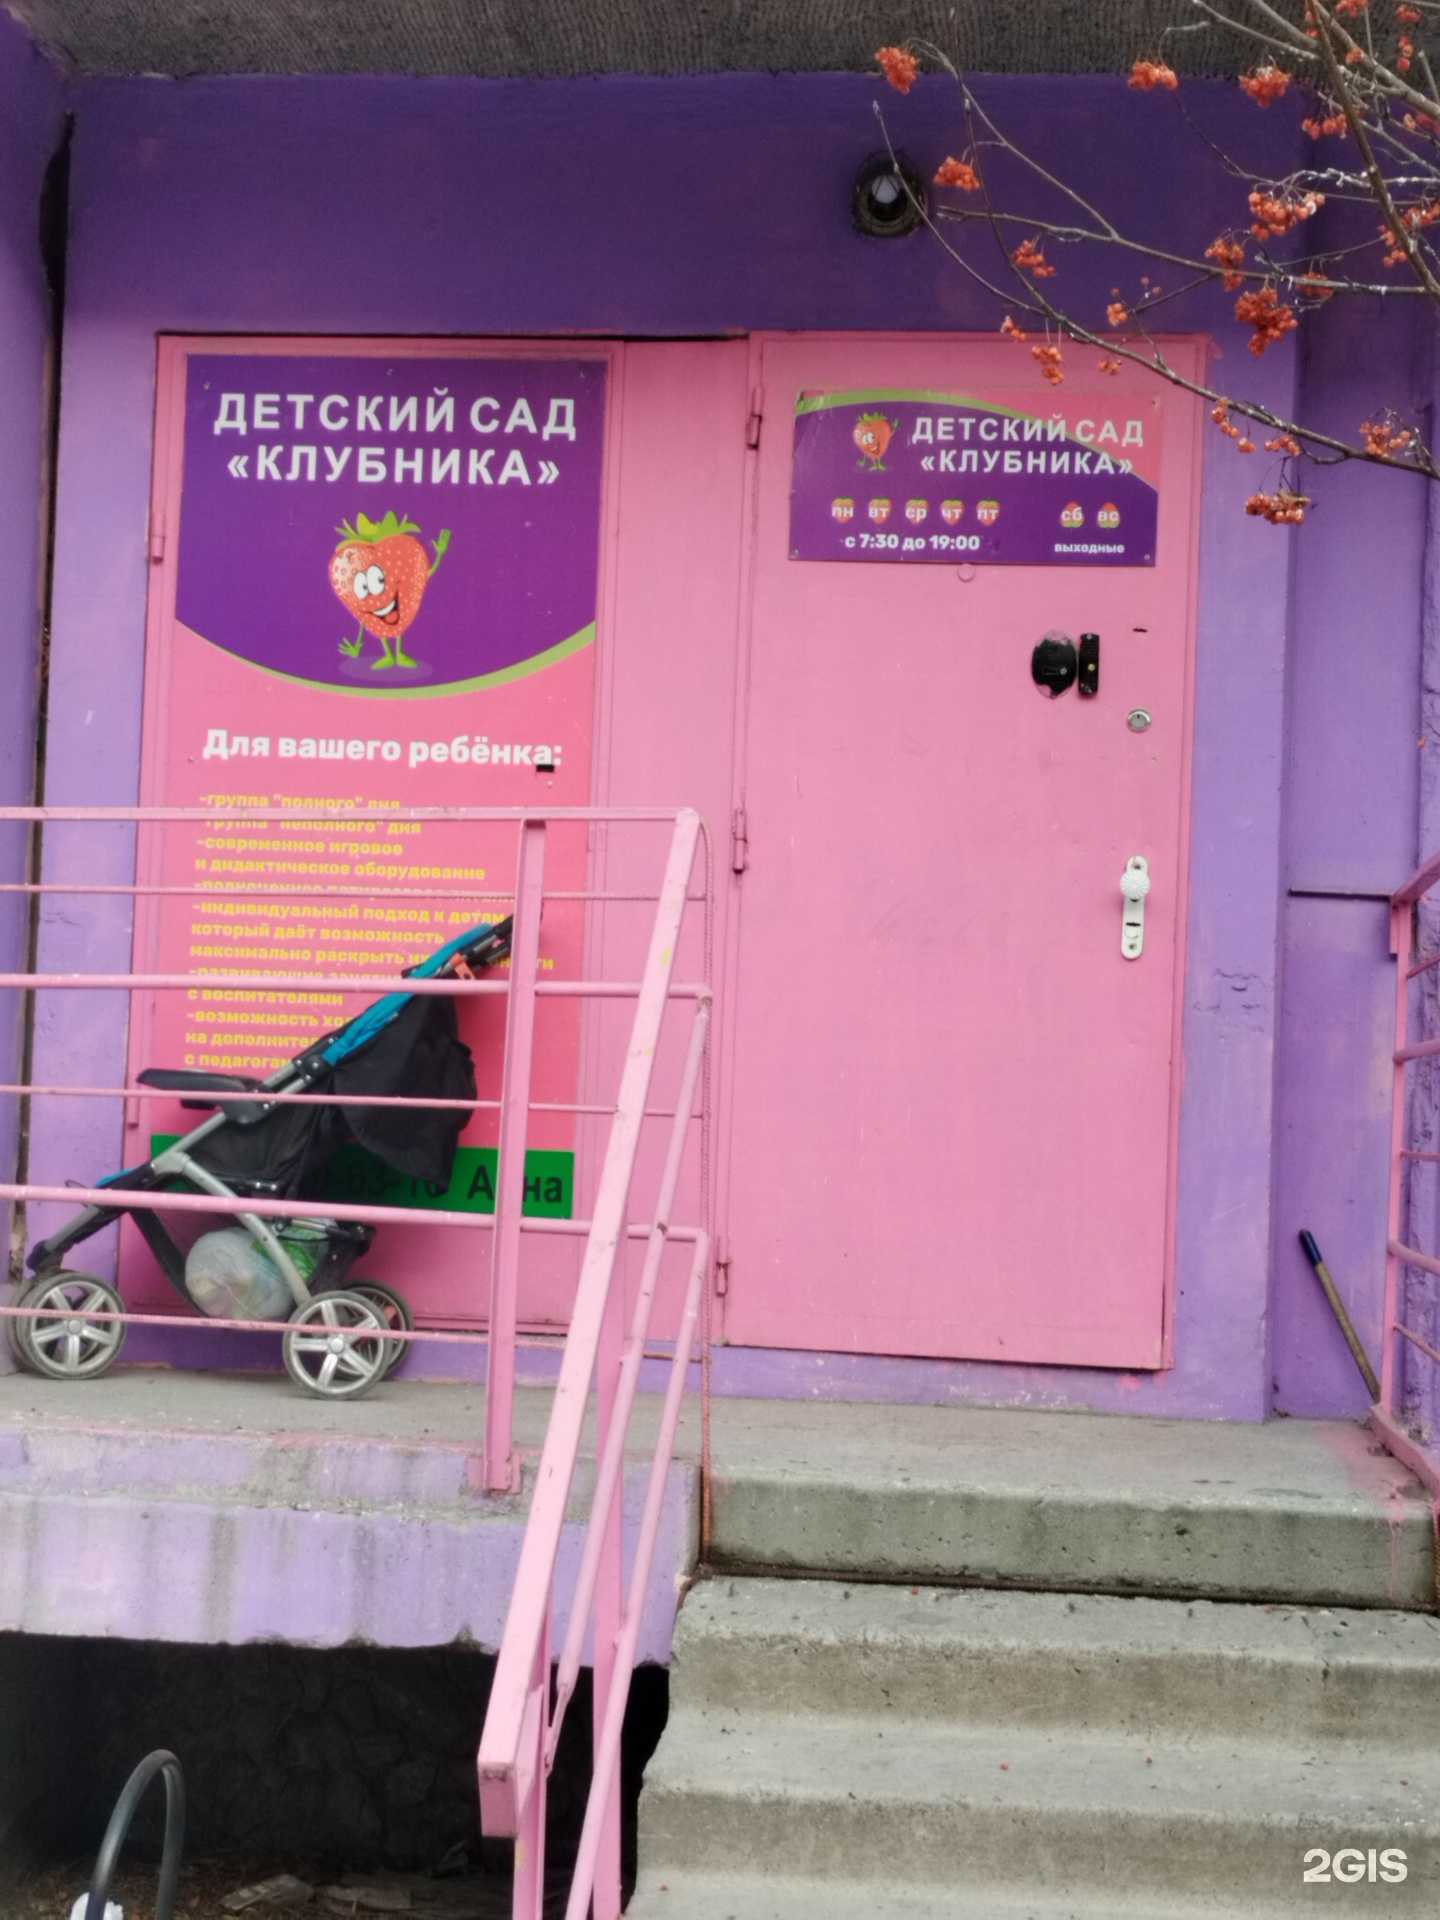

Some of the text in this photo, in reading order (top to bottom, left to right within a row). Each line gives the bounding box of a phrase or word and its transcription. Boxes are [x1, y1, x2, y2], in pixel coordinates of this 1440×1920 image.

[213, 386, 577, 441] ДЕТСКИЙ САД
[912, 413, 1145, 448] ДЕТСКИЙ САД
[227, 444, 560, 486] «КЛУБНИКА»
[921, 449, 1134, 475] «КЛУБНИКА»
[831, 506, 999, 524] пн вт ср чт пт
[1061, 506, 1119, 522] сб вс
[844, 533, 980, 551] с 7:30 до 19:00
[1054, 543, 1125, 554] выходные
[203, 728, 563, 768] Для вашего ребёнка:
[387, 821, 421, 835] дня
[197, 837, 403, 856] -современное игровое
[195, 859, 485, 881] и дидактическое оборудование
[362, 907, 431, 923] подход
[434, 911, 445, 922] к
[191, 922, 445, 944] который даёт возможность
[190, 945, 311, 961] максимально
[315, 949, 404, 967] раскрыть
[187, 989, 344, 1005] с воспитателями
[185, 1032, 208, 1044] на
[185, 1053, 195, 1065] с
[467, 1164, 563, 1204] Ана
